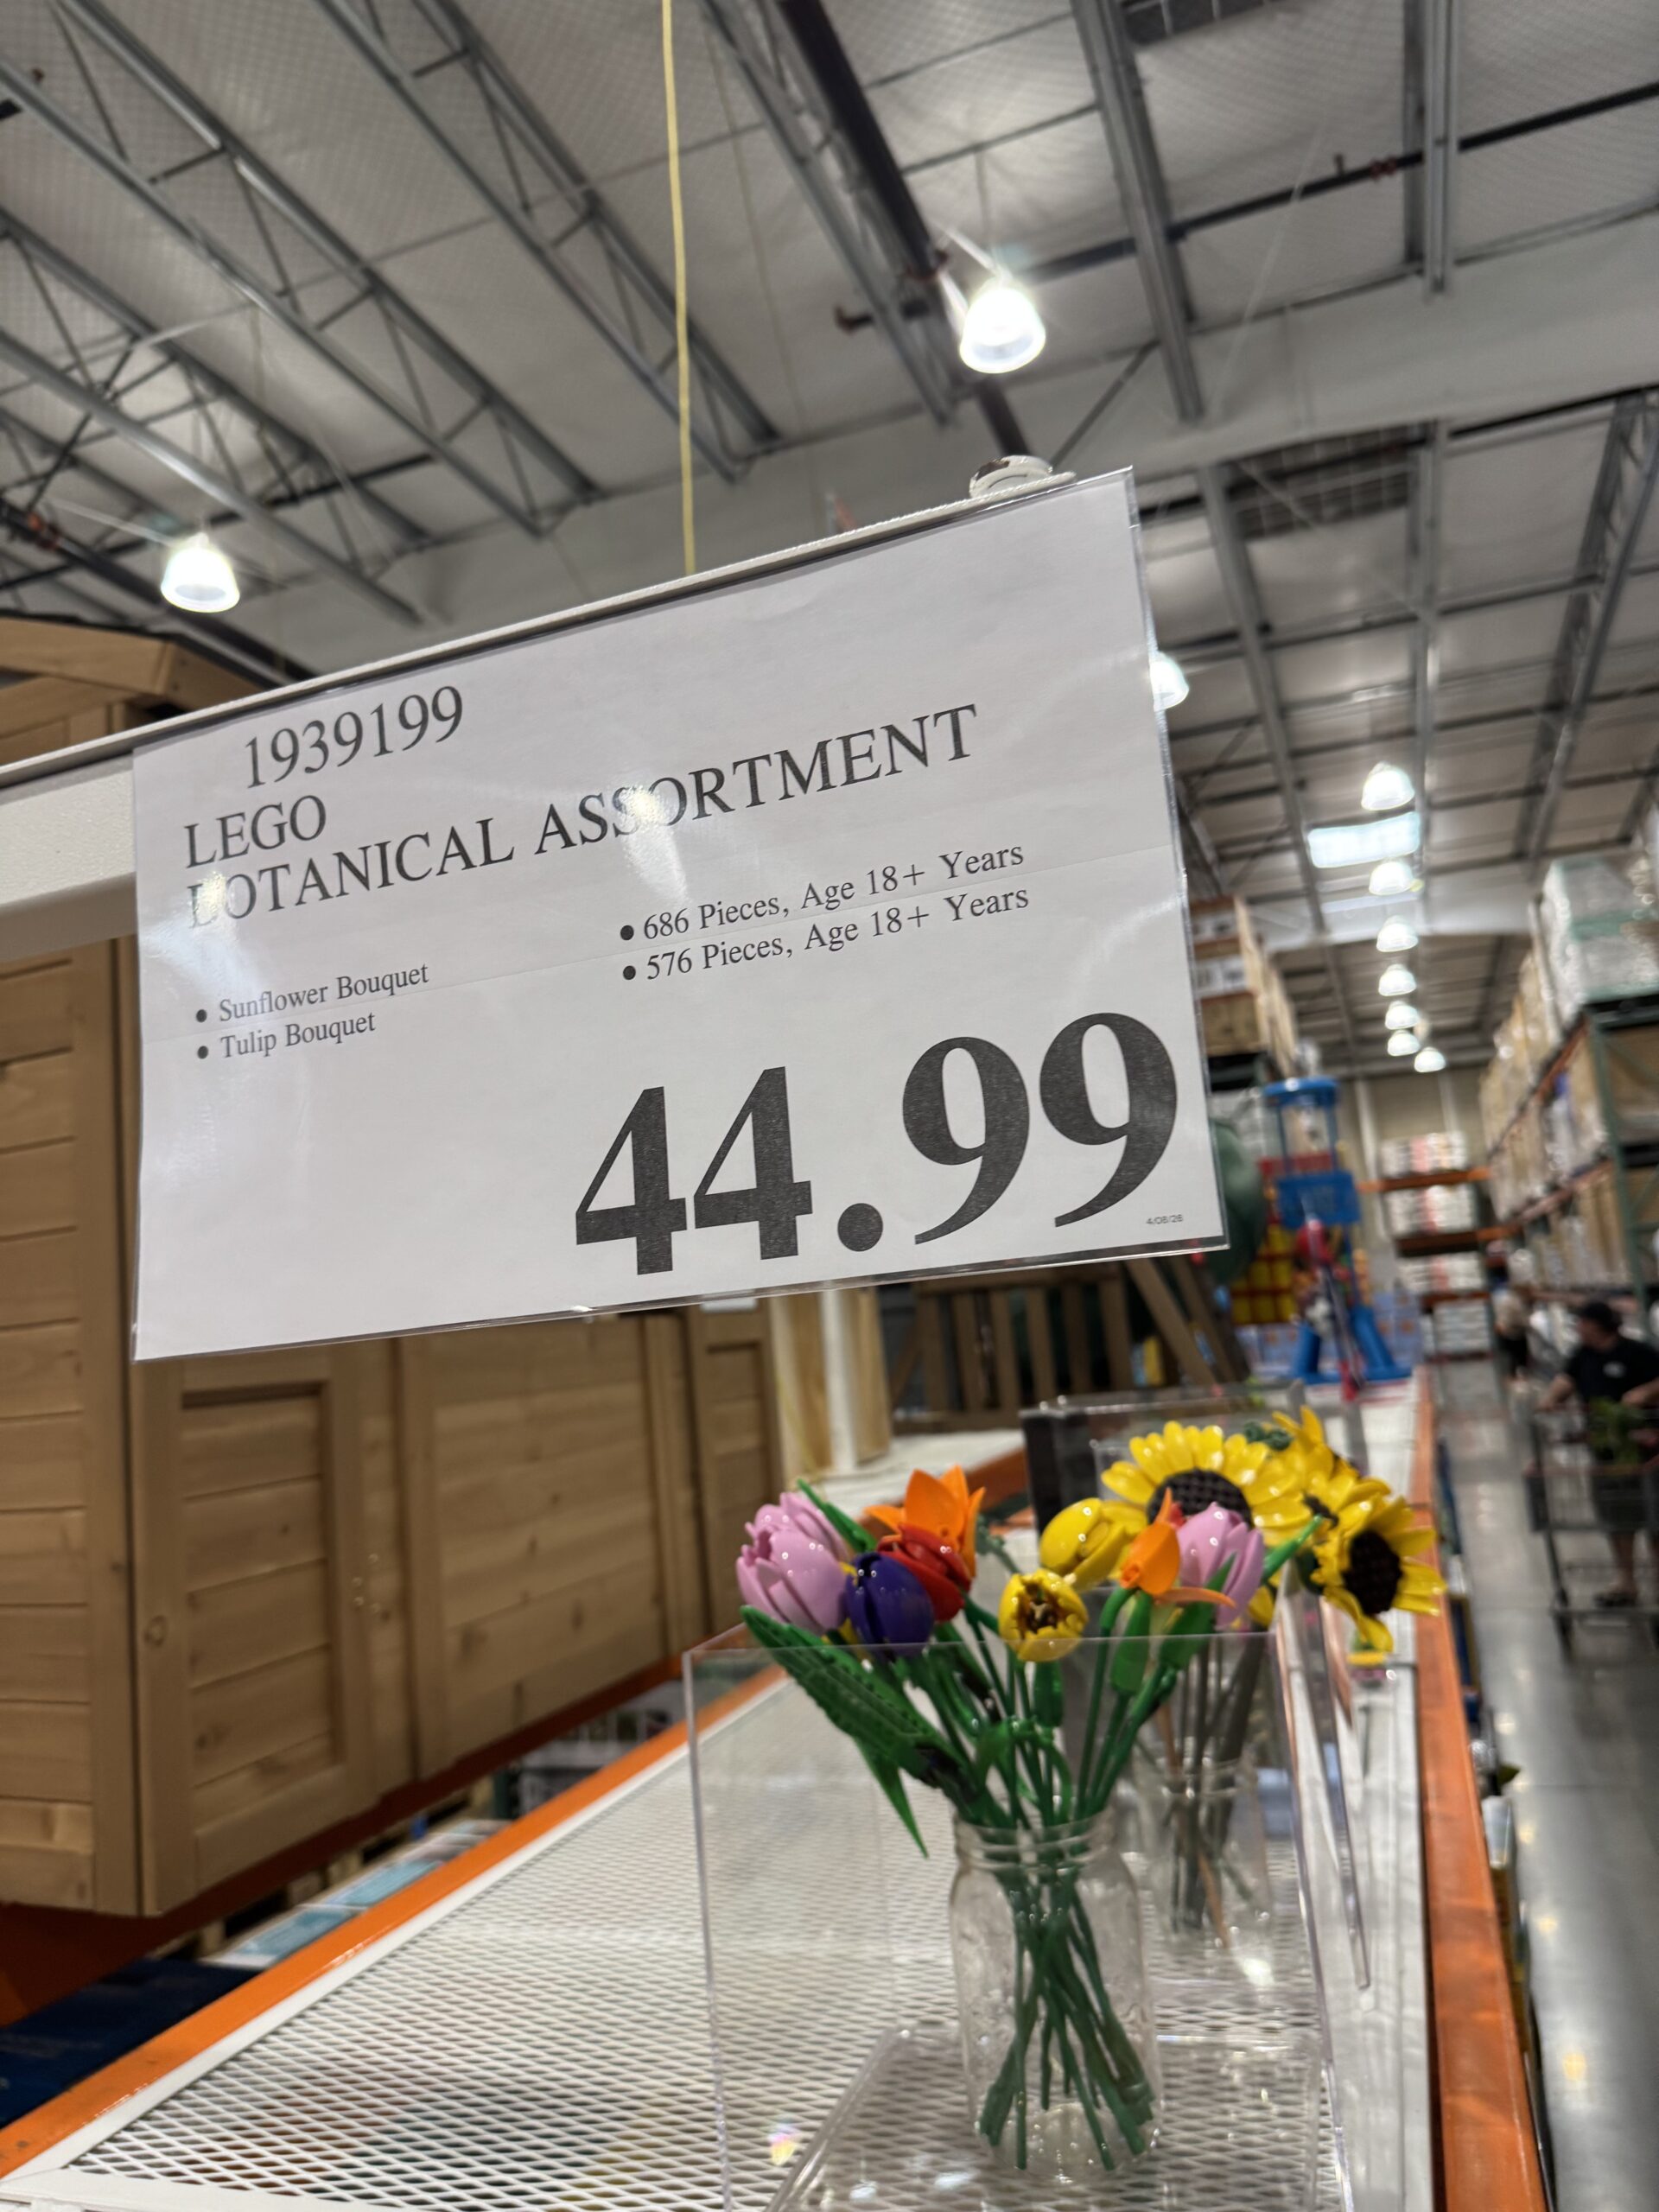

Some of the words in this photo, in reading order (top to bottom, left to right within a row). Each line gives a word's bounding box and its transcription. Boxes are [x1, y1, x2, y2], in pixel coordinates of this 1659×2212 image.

[245, 685, 463, 789] 1939199
[534, 703, 977, 855] ASSORTMENT
[184, 795, 327, 869] LEGO
[643, 908, 690, 940] 686
[698, 896, 790, 930] Pieces,
[800, 882, 855, 912] Age
[867, 863, 925, 896] 18+
[938, 845, 1025, 880] Years
[646, 948, 693, 982] 576
[702, 938, 793, 969] Pieces,
[804, 922, 860, 952] Age
[871, 905, 931, 938] 18+
[943, 887, 1029, 922] Years
[218, 983, 329, 1022] Sunflower
[335, 963, 430, 1001] Bouquet
[219, 1028, 277, 1059] Tulip
[284, 1012, 377, 1048] Bouquet
[575, 1013, 1179, 1275] 44.99
